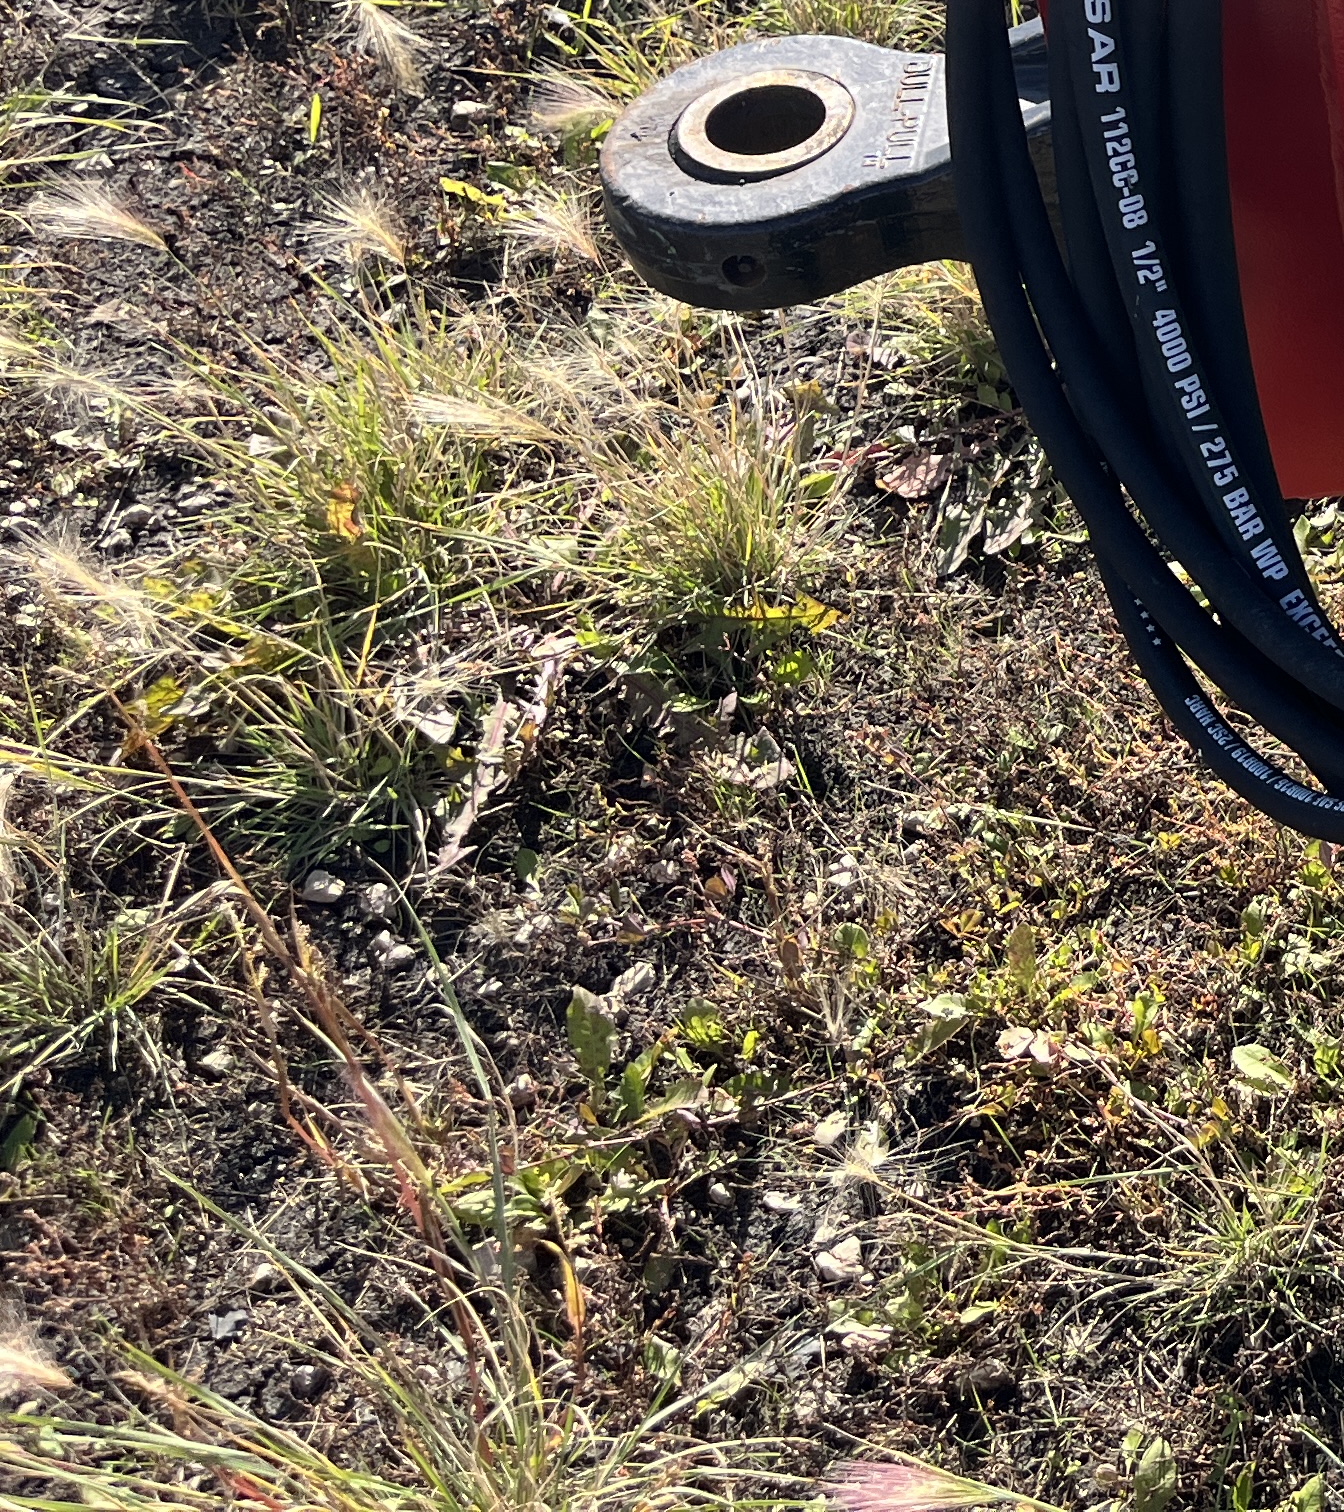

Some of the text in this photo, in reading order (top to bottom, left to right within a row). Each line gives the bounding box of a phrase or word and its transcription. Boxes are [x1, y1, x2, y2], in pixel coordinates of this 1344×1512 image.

[1100, 106, 1149, 230] 112CC-08
[1131, 240, 1168, 292] 1/2"
[1152, 308, 1193, 373] 4000
[1174, 374, 1212, 420] PSI
[1200, 436, 1240, 487] 275
[1222, 486, 1265, 542] BAR
[1249, 537, 1290, 583] WP
[1184, 694, 1215, 729] HARC
[1207, 724, 1234, 746] 2SC
